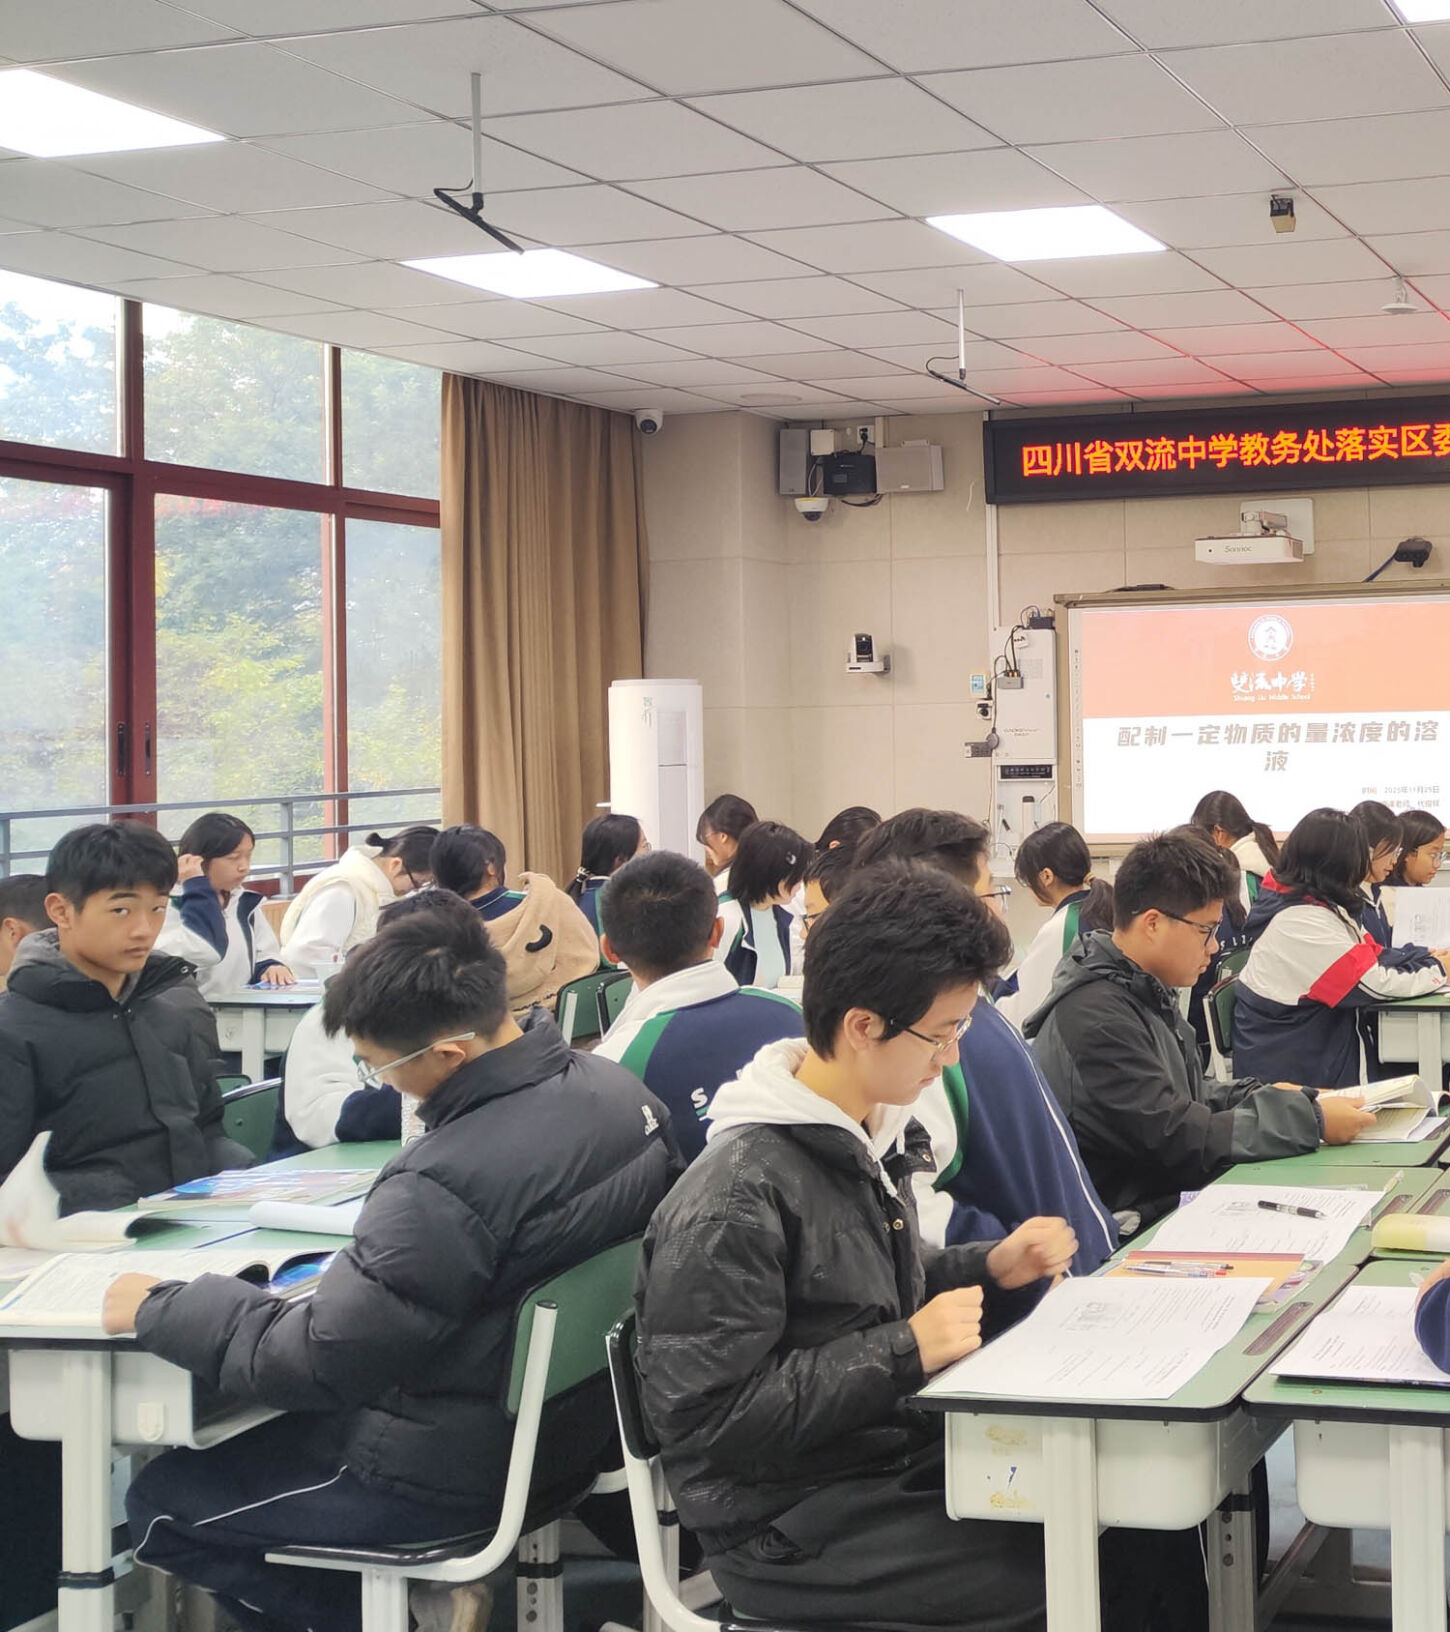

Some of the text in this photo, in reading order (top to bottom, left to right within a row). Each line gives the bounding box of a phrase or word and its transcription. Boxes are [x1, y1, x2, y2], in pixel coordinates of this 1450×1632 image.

[1117, 720, 1439, 747] 配制一定物质的量浓度的溶
[1264, 751, 1289, 771] 液
